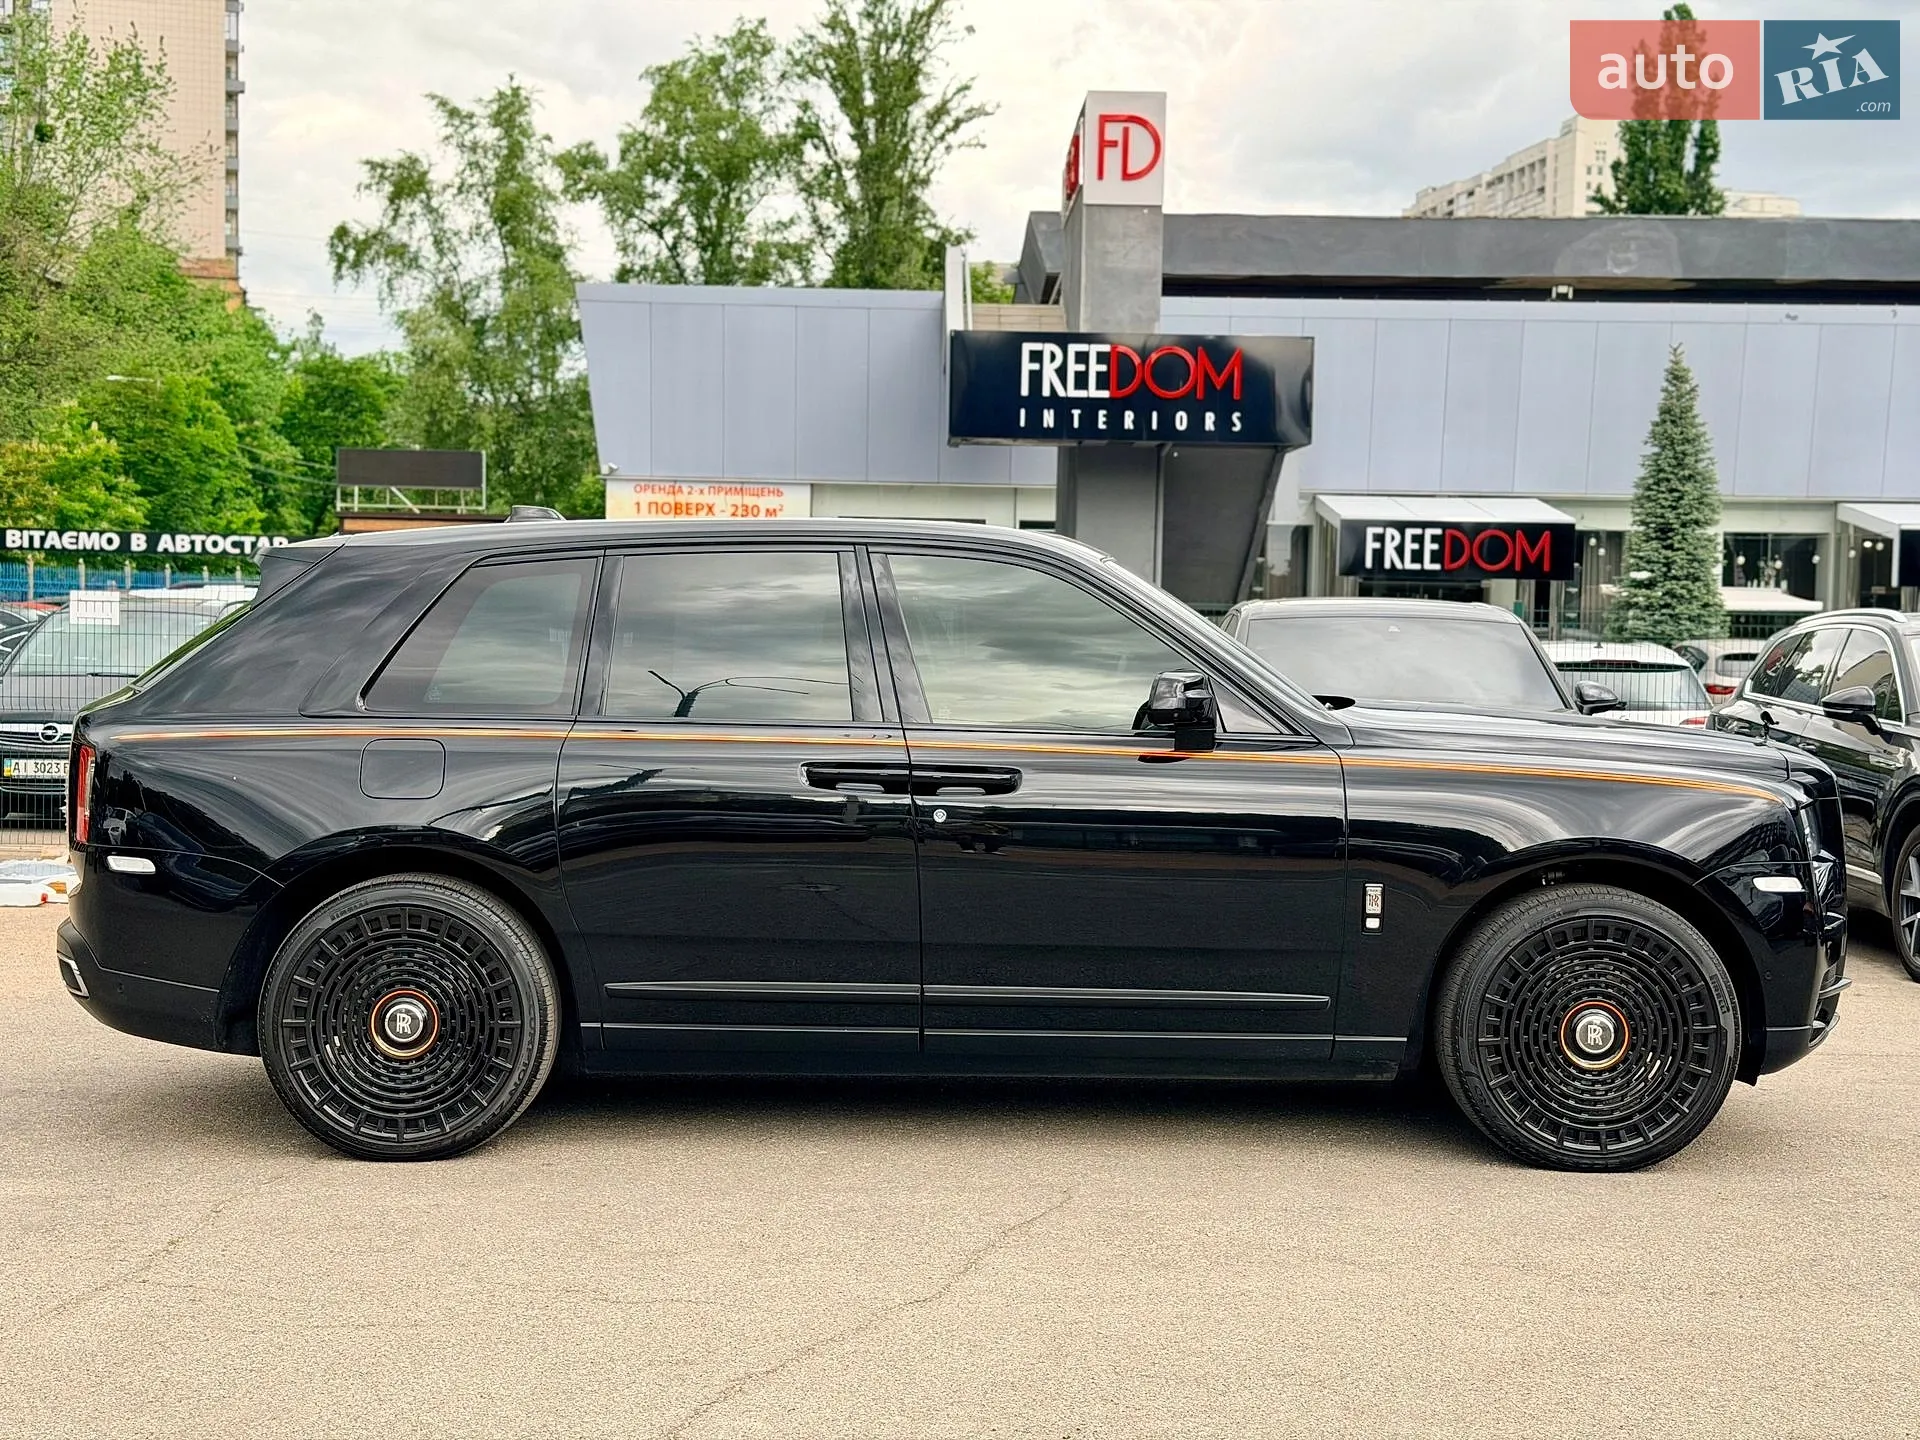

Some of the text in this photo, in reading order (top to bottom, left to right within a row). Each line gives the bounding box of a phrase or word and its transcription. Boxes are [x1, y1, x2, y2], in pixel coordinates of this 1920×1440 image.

[1096, 114, 1162, 182] FD
[1020, 342, 1243, 400] FREEDOM
[1019, 408, 1242, 432] INTERIORS
[634, 484, 684, 495] ОРЕНДА
[708, 486, 785, 498] ПРИМІЩЕНЬ
[635, 502, 641, 515] 1
[648, 502, 716, 517] ПОВЕРХ
[731, 504, 760, 518] 230
[5, 529, 120, 550] ВІТАЄМО
[131, 532, 147, 551] В
[1364, 526, 1551, 572] FREEDOM
[33, 762, 60, 774] 3023
